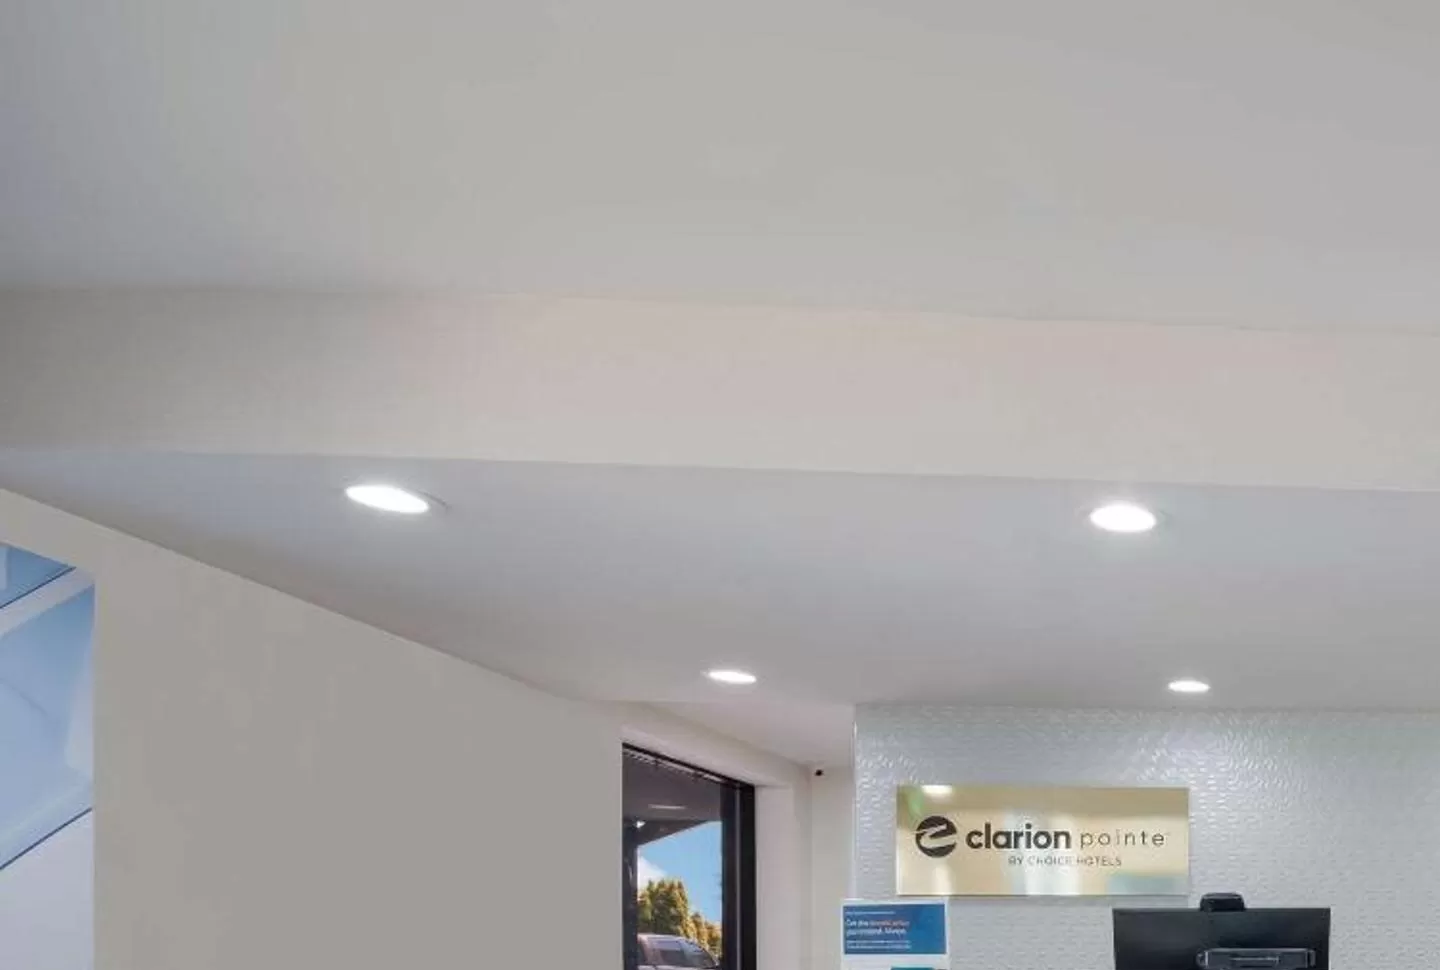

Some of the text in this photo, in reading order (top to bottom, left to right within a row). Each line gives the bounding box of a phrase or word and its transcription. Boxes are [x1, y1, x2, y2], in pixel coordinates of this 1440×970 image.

[966, 822, 1166, 850] clarion pointe
[1076, 856, 1122, 867] HOTELS
